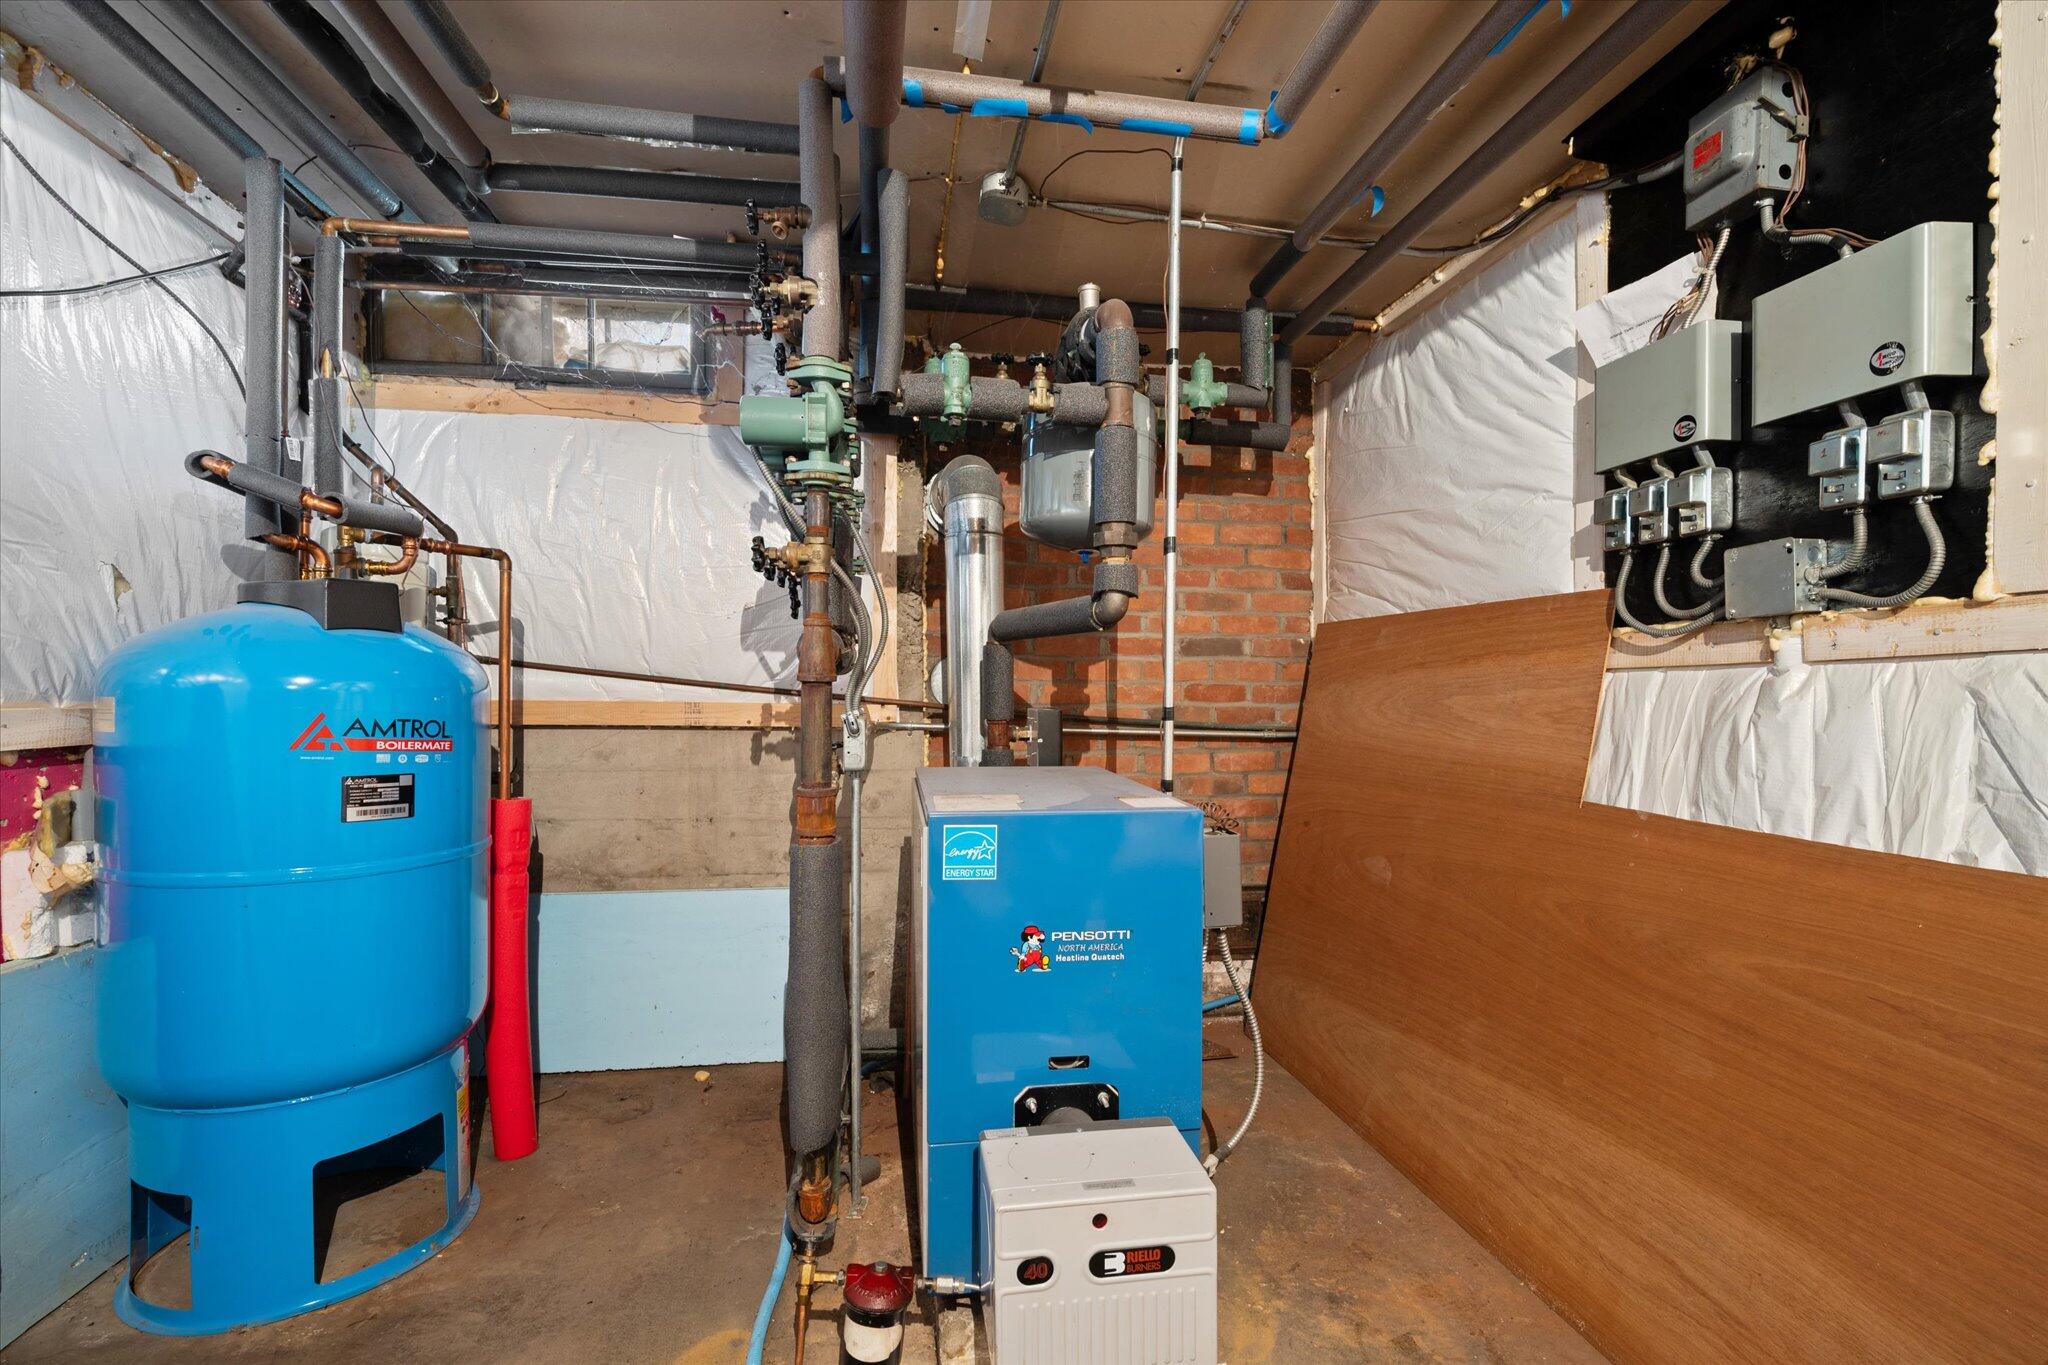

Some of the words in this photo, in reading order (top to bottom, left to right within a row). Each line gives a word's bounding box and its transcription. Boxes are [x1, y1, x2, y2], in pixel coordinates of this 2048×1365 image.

[342, 717, 451, 738] AMTROL
[376, 741, 451, 750] BOILERMATE
[948, 847, 979, 861] energy
[946, 868, 974, 877] ENERGY
[976, 868, 994, 877] STAR
[1051, 930, 1131, 942] PENSOTTI
[1058, 944, 1086, 952] NORTH
[1087, 943, 1124, 951] AMERICA
[1055, 954, 1089, 962] Heatline
[1091, 953, 1125, 961] Quatech
[1126, 1248, 1161, 1263] RIELLO
[1024, 1263, 1048, 1279] 40
[1126, 1261, 1161, 1274] BURNERS
